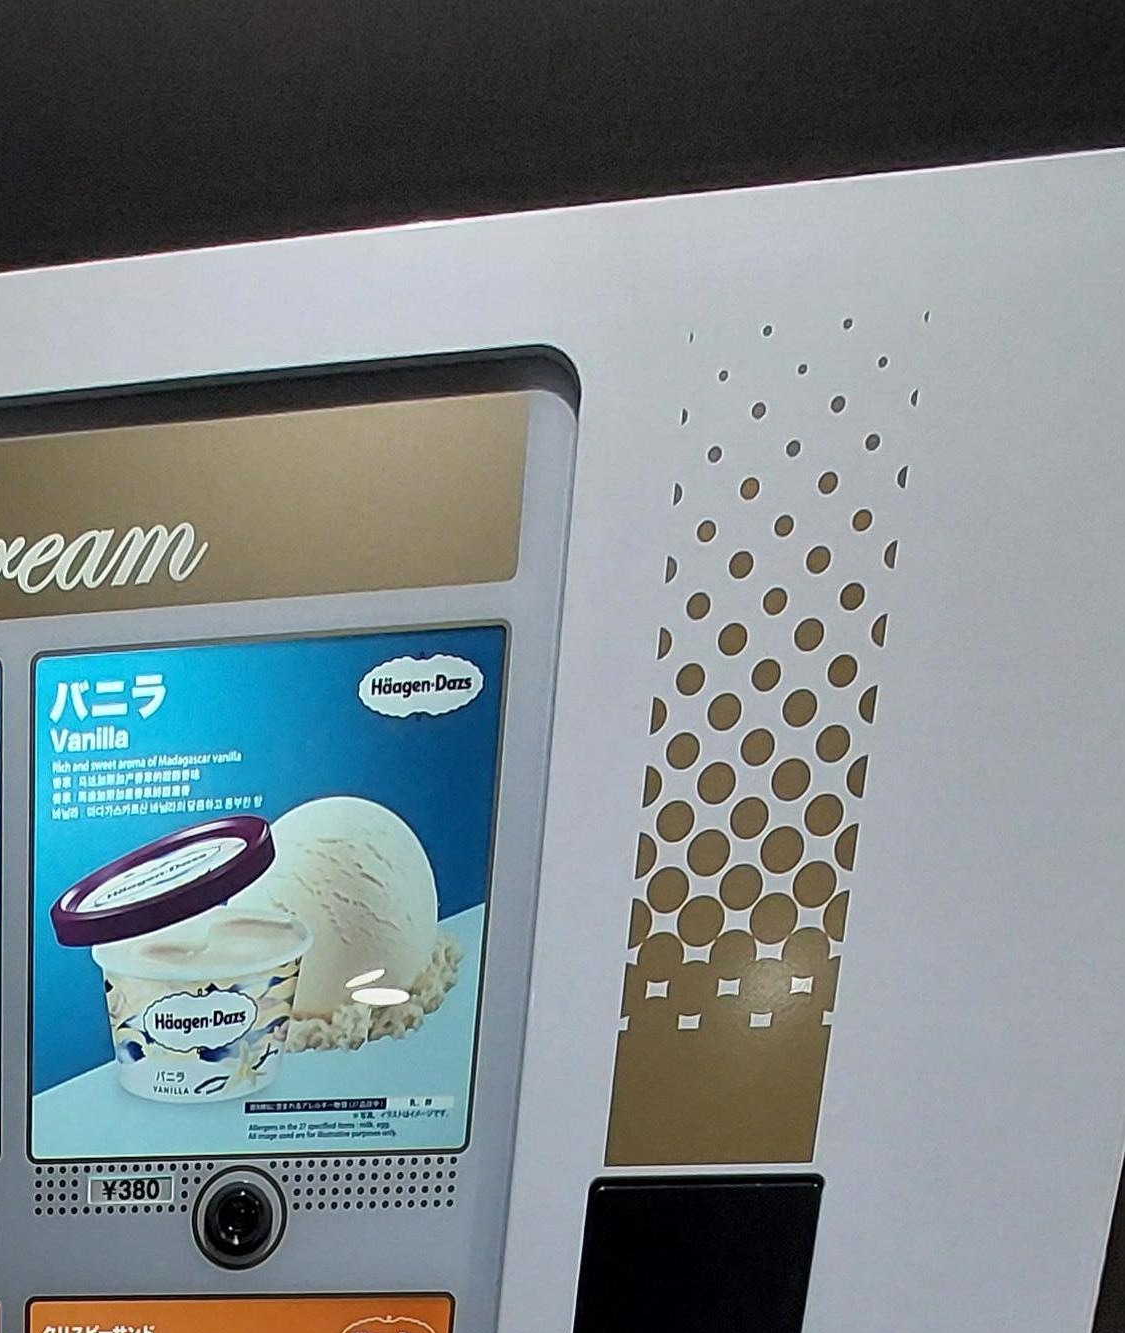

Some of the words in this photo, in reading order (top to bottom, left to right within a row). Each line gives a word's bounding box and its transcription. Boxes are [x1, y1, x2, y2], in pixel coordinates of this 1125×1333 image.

[49, 673, 167, 723] バニラ
[371, 676, 472, 699] Häagen-Dazs
[50, 725, 129, 753] Vanilla
[52, 761, 70, 773] Rich
[74, 760, 89, 771] and
[91, 759, 117, 770] sweet
[147, 756, 158, 768] of
[159, 753, 211, 768] Madagascar
[212, 751, 241, 764] vanilla
[154, 1010, 247, 1034] Häagen-Dazs
[155, 1070, 185, 1084] バニラ
[152, 1085, 189, 1095] VANILLA
[101, 1178, 159, 1200] ¥380
